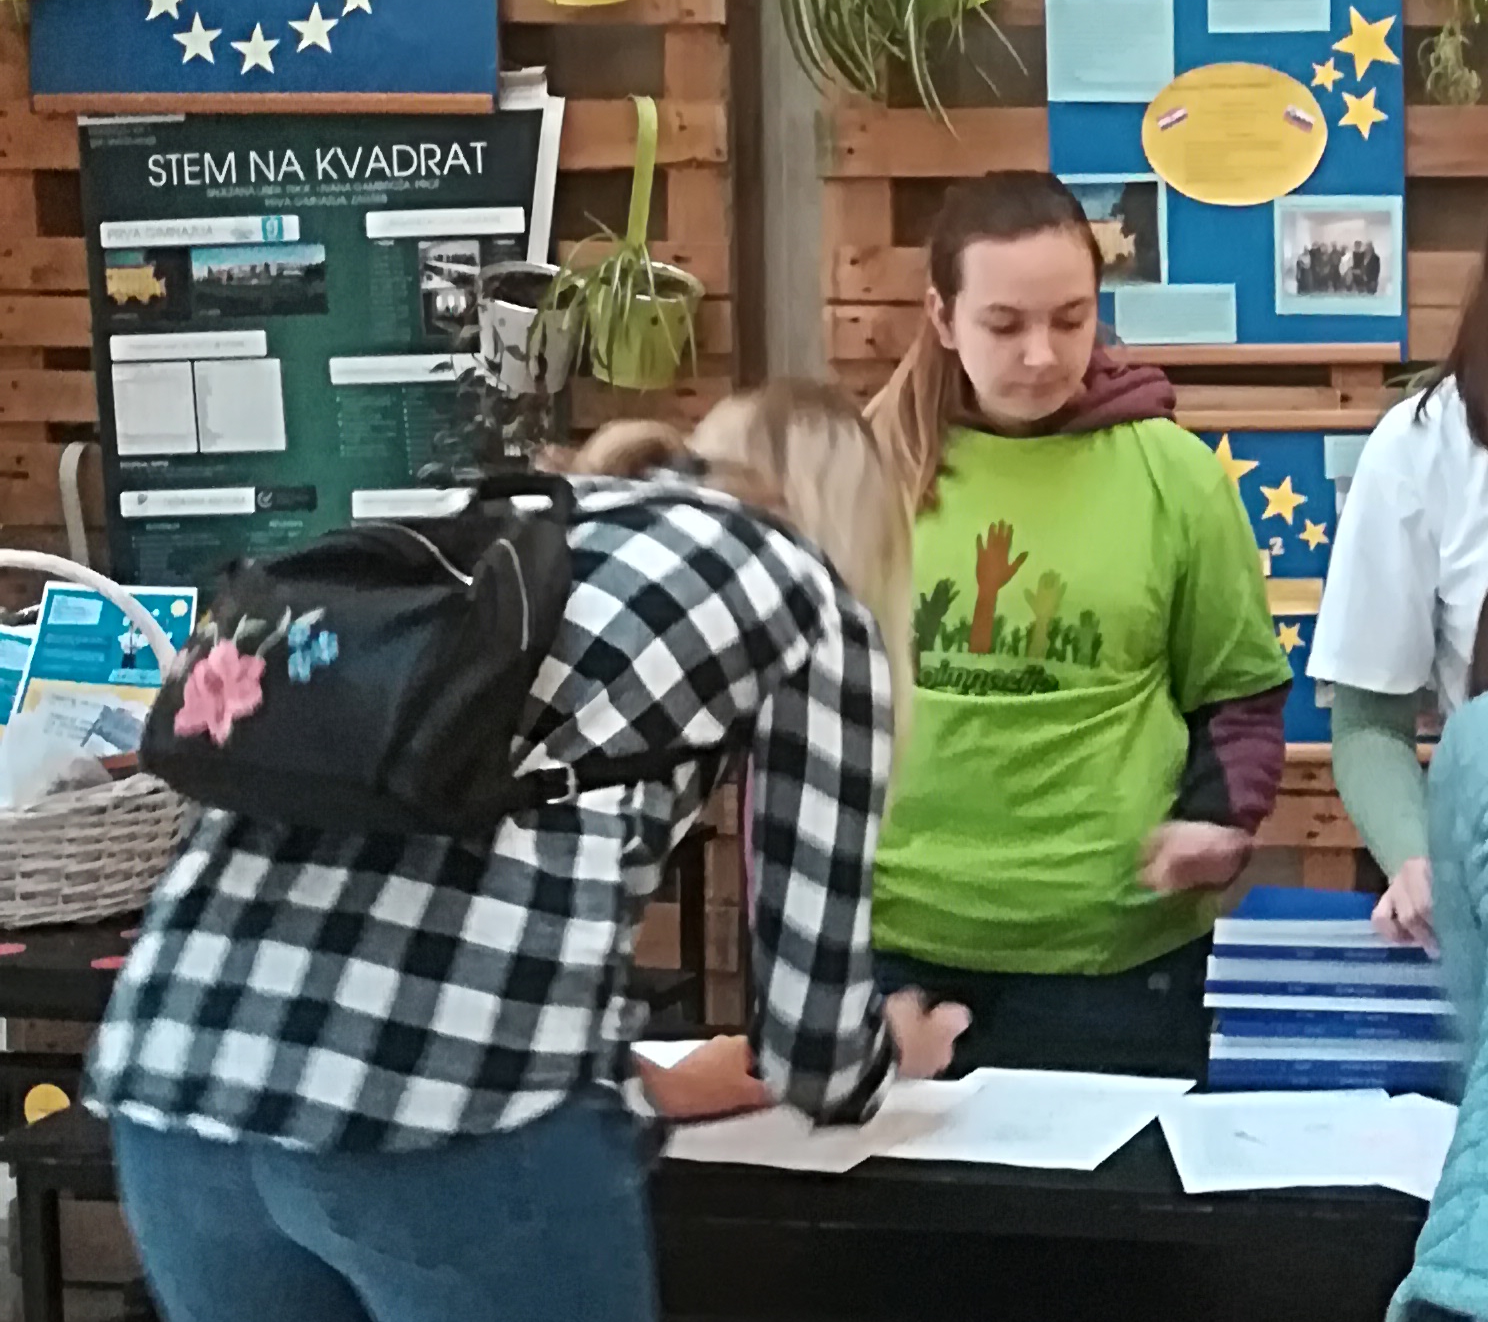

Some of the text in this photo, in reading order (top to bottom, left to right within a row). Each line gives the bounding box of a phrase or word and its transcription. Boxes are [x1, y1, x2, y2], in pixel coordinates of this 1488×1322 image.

[147, 141, 487, 187] STEM NA KVADRAT
